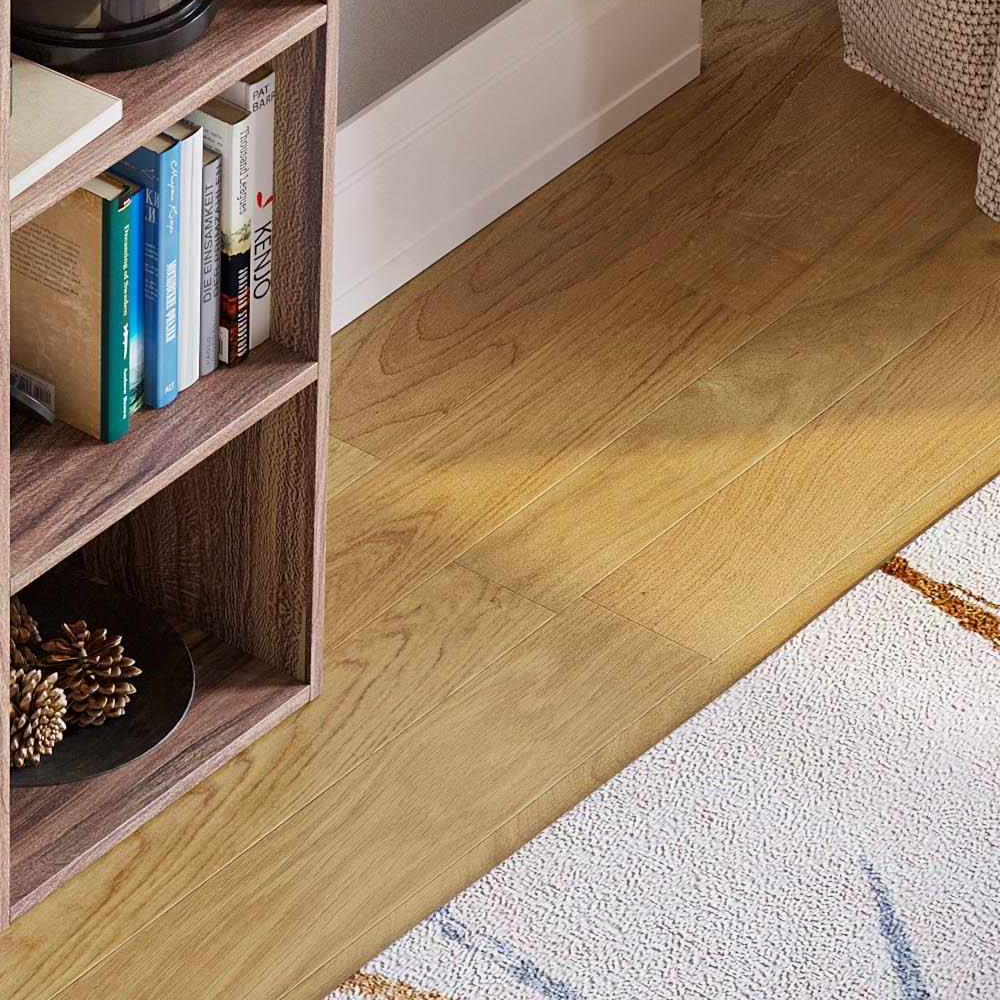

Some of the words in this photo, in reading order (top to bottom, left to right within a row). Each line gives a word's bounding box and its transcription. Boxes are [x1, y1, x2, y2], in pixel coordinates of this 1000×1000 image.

[253, 84, 269, 100] PAT
[239, 127, 250, 178] Thousand
[237, 177, 248, 216] Leagues
[203, 184, 213, 275] EINSAMKEIT
[254, 221, 272, 300] KENJO
[203, 280, 211, 304] DIE
